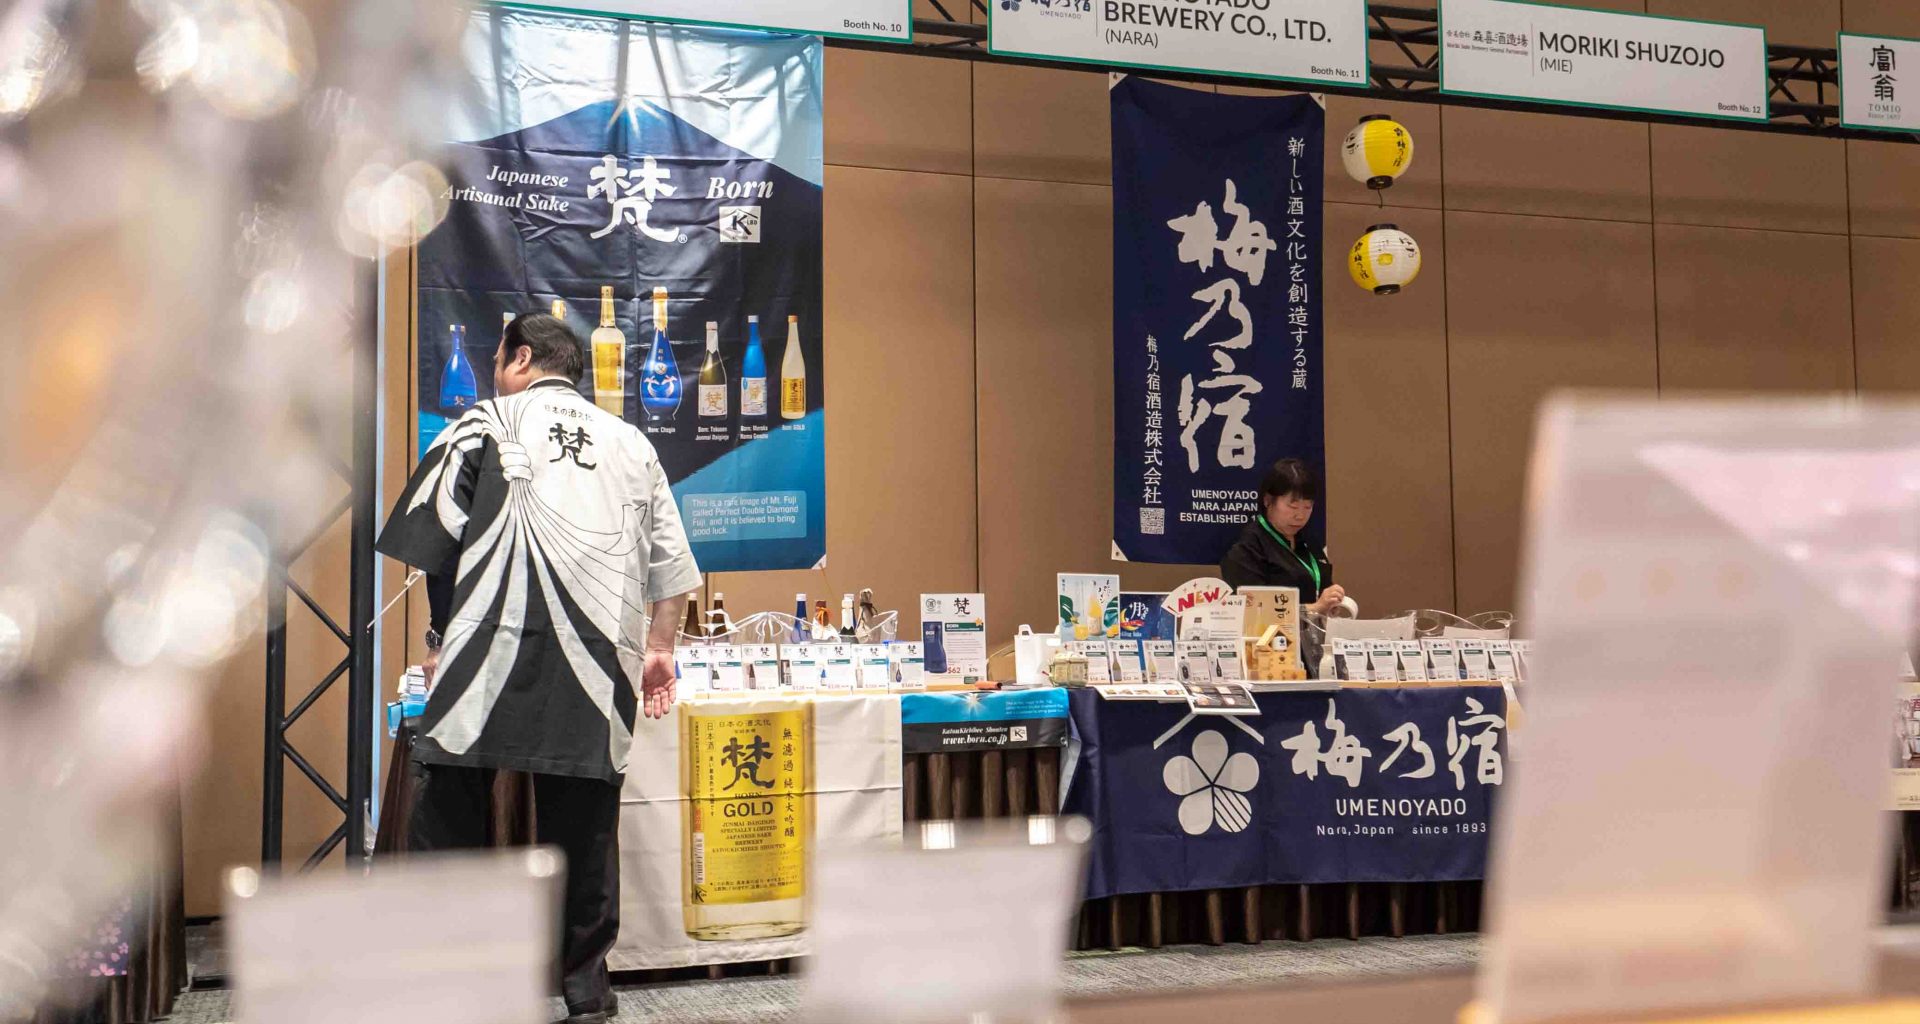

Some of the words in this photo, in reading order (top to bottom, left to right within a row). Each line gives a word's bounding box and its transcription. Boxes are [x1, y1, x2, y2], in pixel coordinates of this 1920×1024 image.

[1040, 10, 1082, 19] UMENOYADO
[1104, 1, 1225, 32] BREWERY
[1231, 13, 1277, 40] CO.,
[1284, 18, 1331, 43] LTD.
[843, 19, 870, 30] Booth
[873, 22, 888, 31] No.
[891, 24, 902, 32] 10
[1105, 28, 1159, 48] (NARA)
[1539, 31, 1619, 58] MORIKI
[1625, 40, 1725, 68] SHUZOJO
[1311, 65, 1333, 76] Booth
[1335, 68, 1348, 77] No.
[1351, 70, 1360, 78] 11
[1540, 57, 1573, 74] (MIE)
[1868, 44, 1898, 101] 富翁
[1718, 102, 1737, 112] Booth
[1739, 104, 1750, 113] No.
[1868, 104, 1901, 113] TOMIO
[486, 165, 569, 188] Japanese
[705, 176, 775, 200] Born
[440, 184, 523, 209] Artisanal
[525, 193, 570, 212] Sake
[587, 155, 680, 243] 梵
[1286, 136, 1309, 390] 新しい酒文化を創造する蔵
[1166, 178, 1278, 474] 梅乃宿
[1142, 334, 1164, 505] 梅乃宿酒造株式会社
[549, 422, 597, 471] 梵
[693, 499, 707, 507] This
[740, 497, 759, 507] image
[761, 497, 769, 505] of
[770, 496, 780, 505] Mt.
[783, 495, 796, 505] Fuji
[1191, 489, 1259, 500] UMENOYADO
[692, 508, 713, 517] called
[715, 507, 740, 516] Perfect
[741, 506, 765, 514] Double
[766, 505, 799, 514] Diamond
[1192, 501, 1220, 511] NARA
[1222, 502, 1258, 511] JAPAN
[709, 517, 722, 525] and
[739, 515, 766, 524] believed
[768, 515, 775, 523] to
[776, 515, 796, 524] bring
[1180, 512, 1248, 523] ESTABLISHED
[692, 528, 710, 537] good
[953, 597, 971, 615] 梵
[1178, 587, 1219, 612] NEW
[947, 666, 961, 674] $62
[942, 733, 1008, 745] www.born.co.jp
[1280, 696, 1505, 791] 梅乃宿
[721, 735, 776, 791] 梵
[724, 801, 774, 817] GOLD
[1336, 798, 1467, 816] UMENOYADO
[1412, 823, 1449, 835] since
[1455, 822, 1486, 834] 1893
